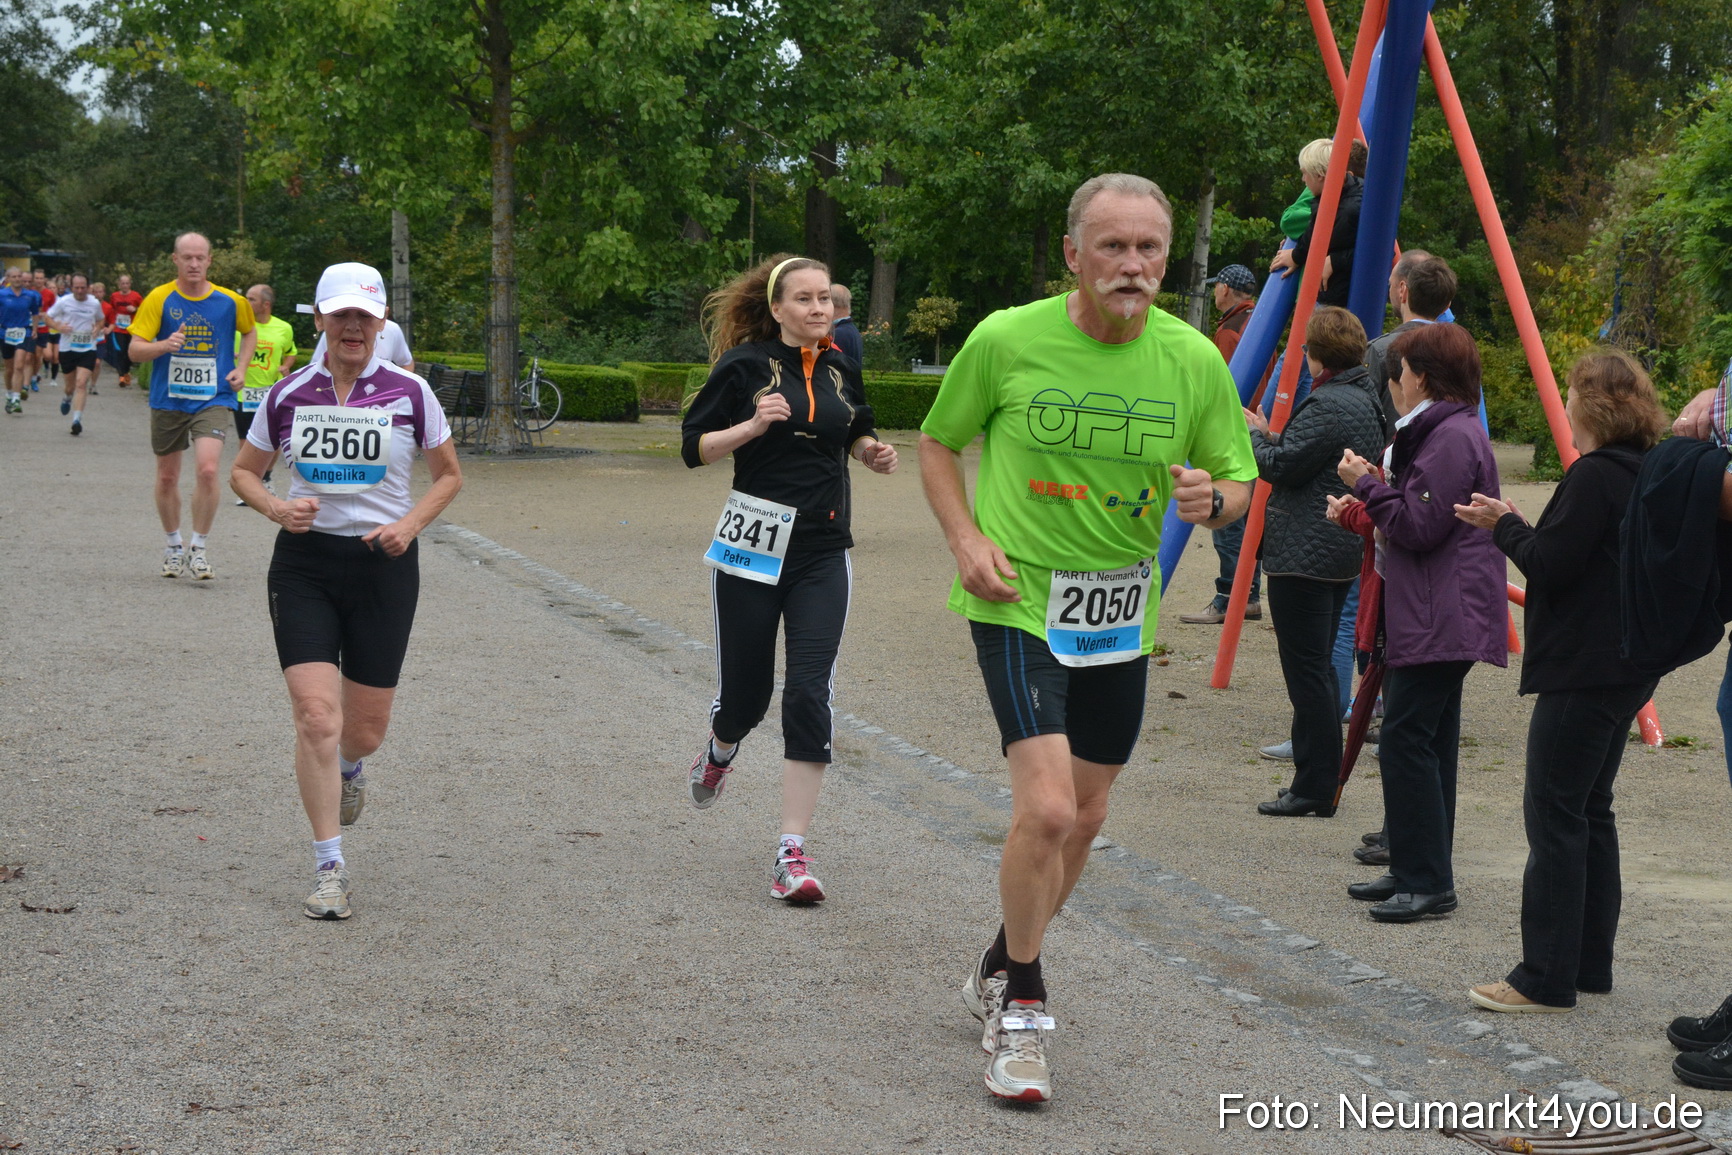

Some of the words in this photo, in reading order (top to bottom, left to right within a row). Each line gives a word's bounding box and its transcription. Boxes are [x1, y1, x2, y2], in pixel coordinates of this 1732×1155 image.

[173, 367, 211, 384] 2081
[296, 414, 326, 423] PARTL
[328, 414, 374, 425] Neumarkt
[1027, 388, 1176, 456] OPF
[301, 427, 381, 461] 2560
[1059, 450, 1072, 458] und
[1073, 452, 1151, 467] Automatisierungstechnik
[312, 467, 366, 483] Angelika
[1026, 487, 1075, 508] Reisen
[1029, 478, 1089, 500] MERZ
[740, 502, 778, 519] Neumarkt
[719, 509, 780, 552] 2341
[723, 549, 751, 567] Petra
[1054, 570, 1094, 581] PARTL
[1096, 570, 1139, 581] Neumarkt
[1059, 584, 1142, 626] 2050
[1076, 636, 1118, 652] Werner
